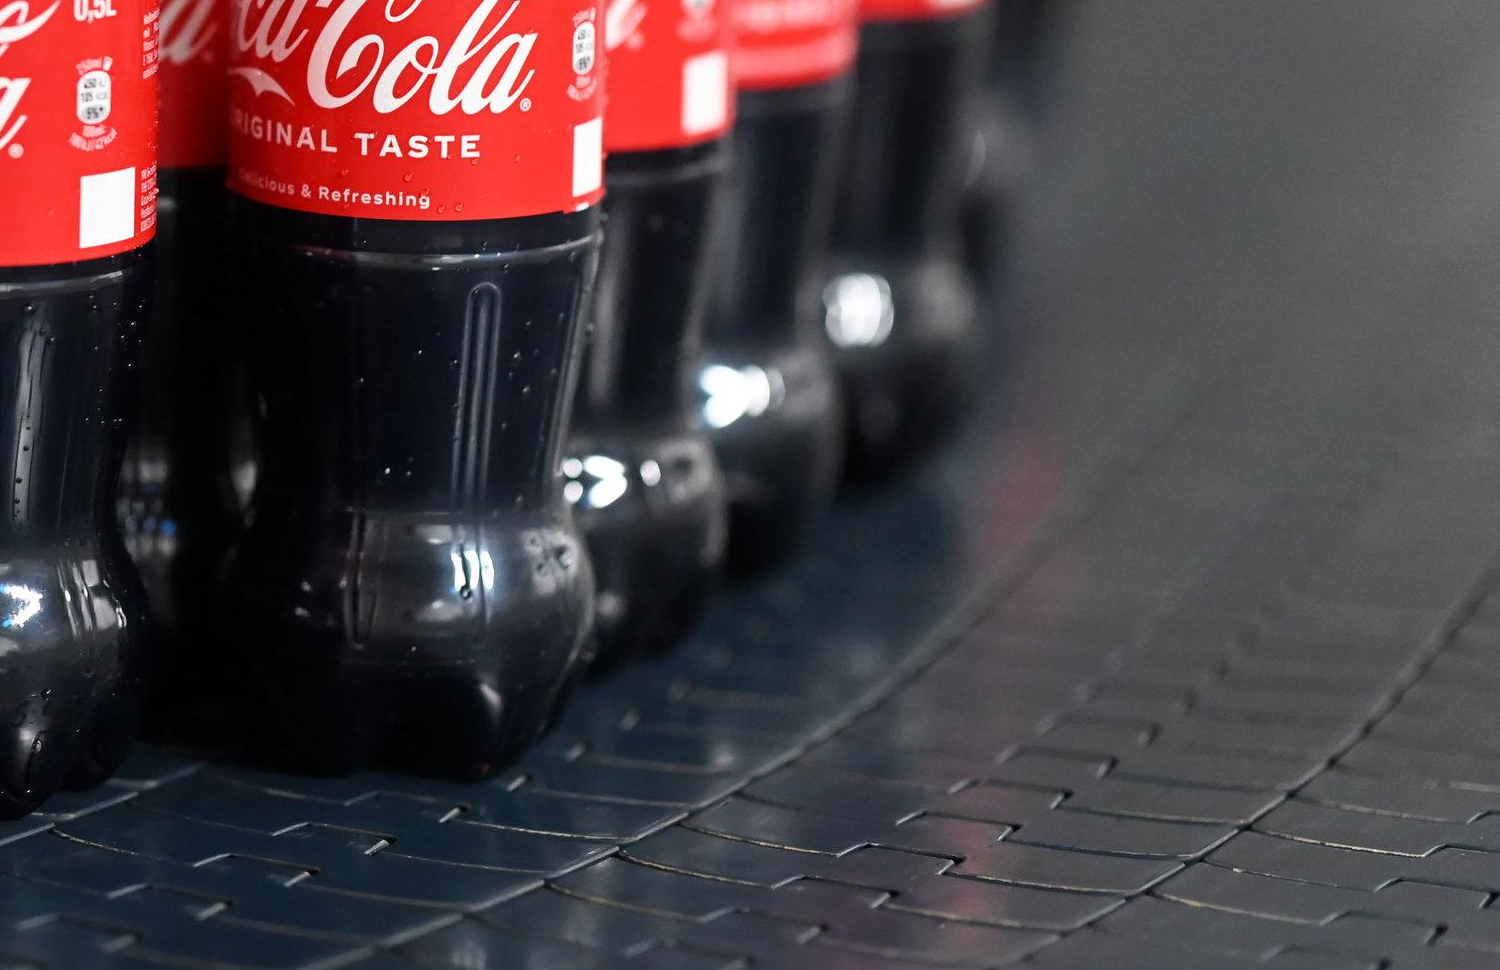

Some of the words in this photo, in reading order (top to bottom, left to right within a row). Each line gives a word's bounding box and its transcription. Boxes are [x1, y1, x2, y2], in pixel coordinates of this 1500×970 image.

[354, 132, 481, 159] TASTE
[301, 184, 312, 198] &
[319, 186, 431, 210] Refreshing
